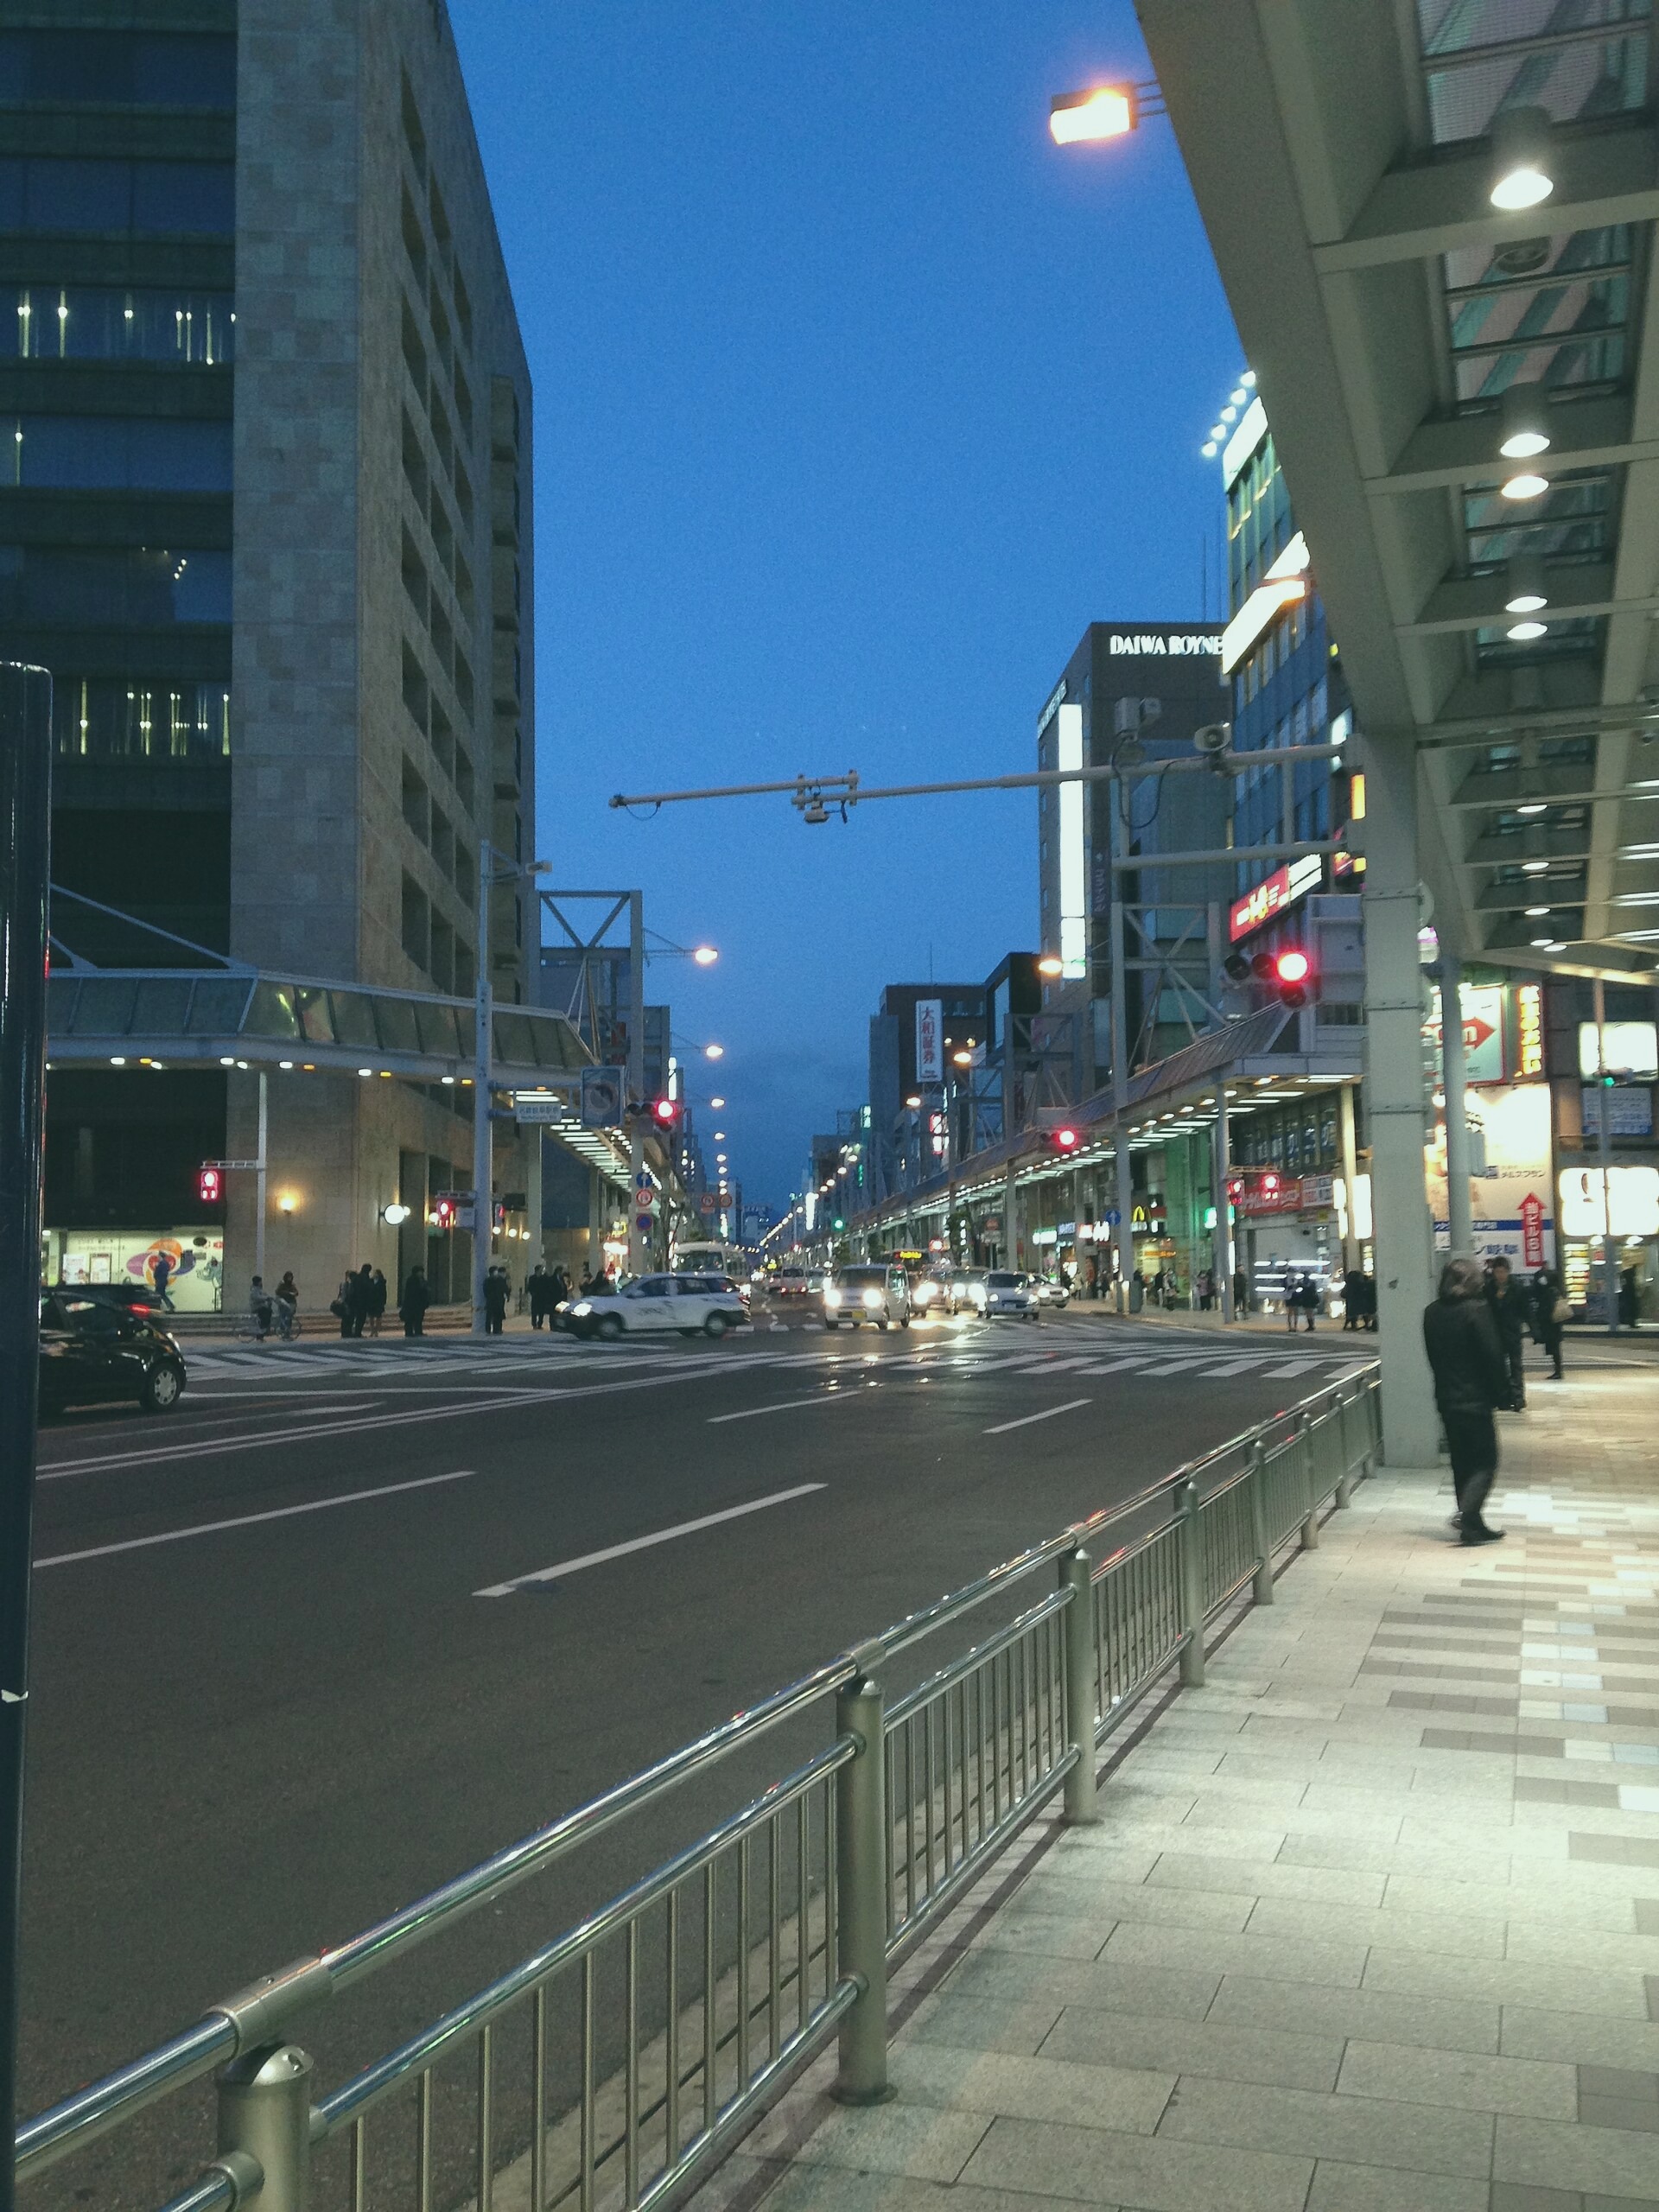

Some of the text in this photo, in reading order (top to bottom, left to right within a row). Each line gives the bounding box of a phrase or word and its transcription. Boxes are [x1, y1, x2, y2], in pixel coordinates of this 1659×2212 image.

[1109, 634, 1167, 656] DAIWA
[921, 1006, 935, 1065] 大和証券
